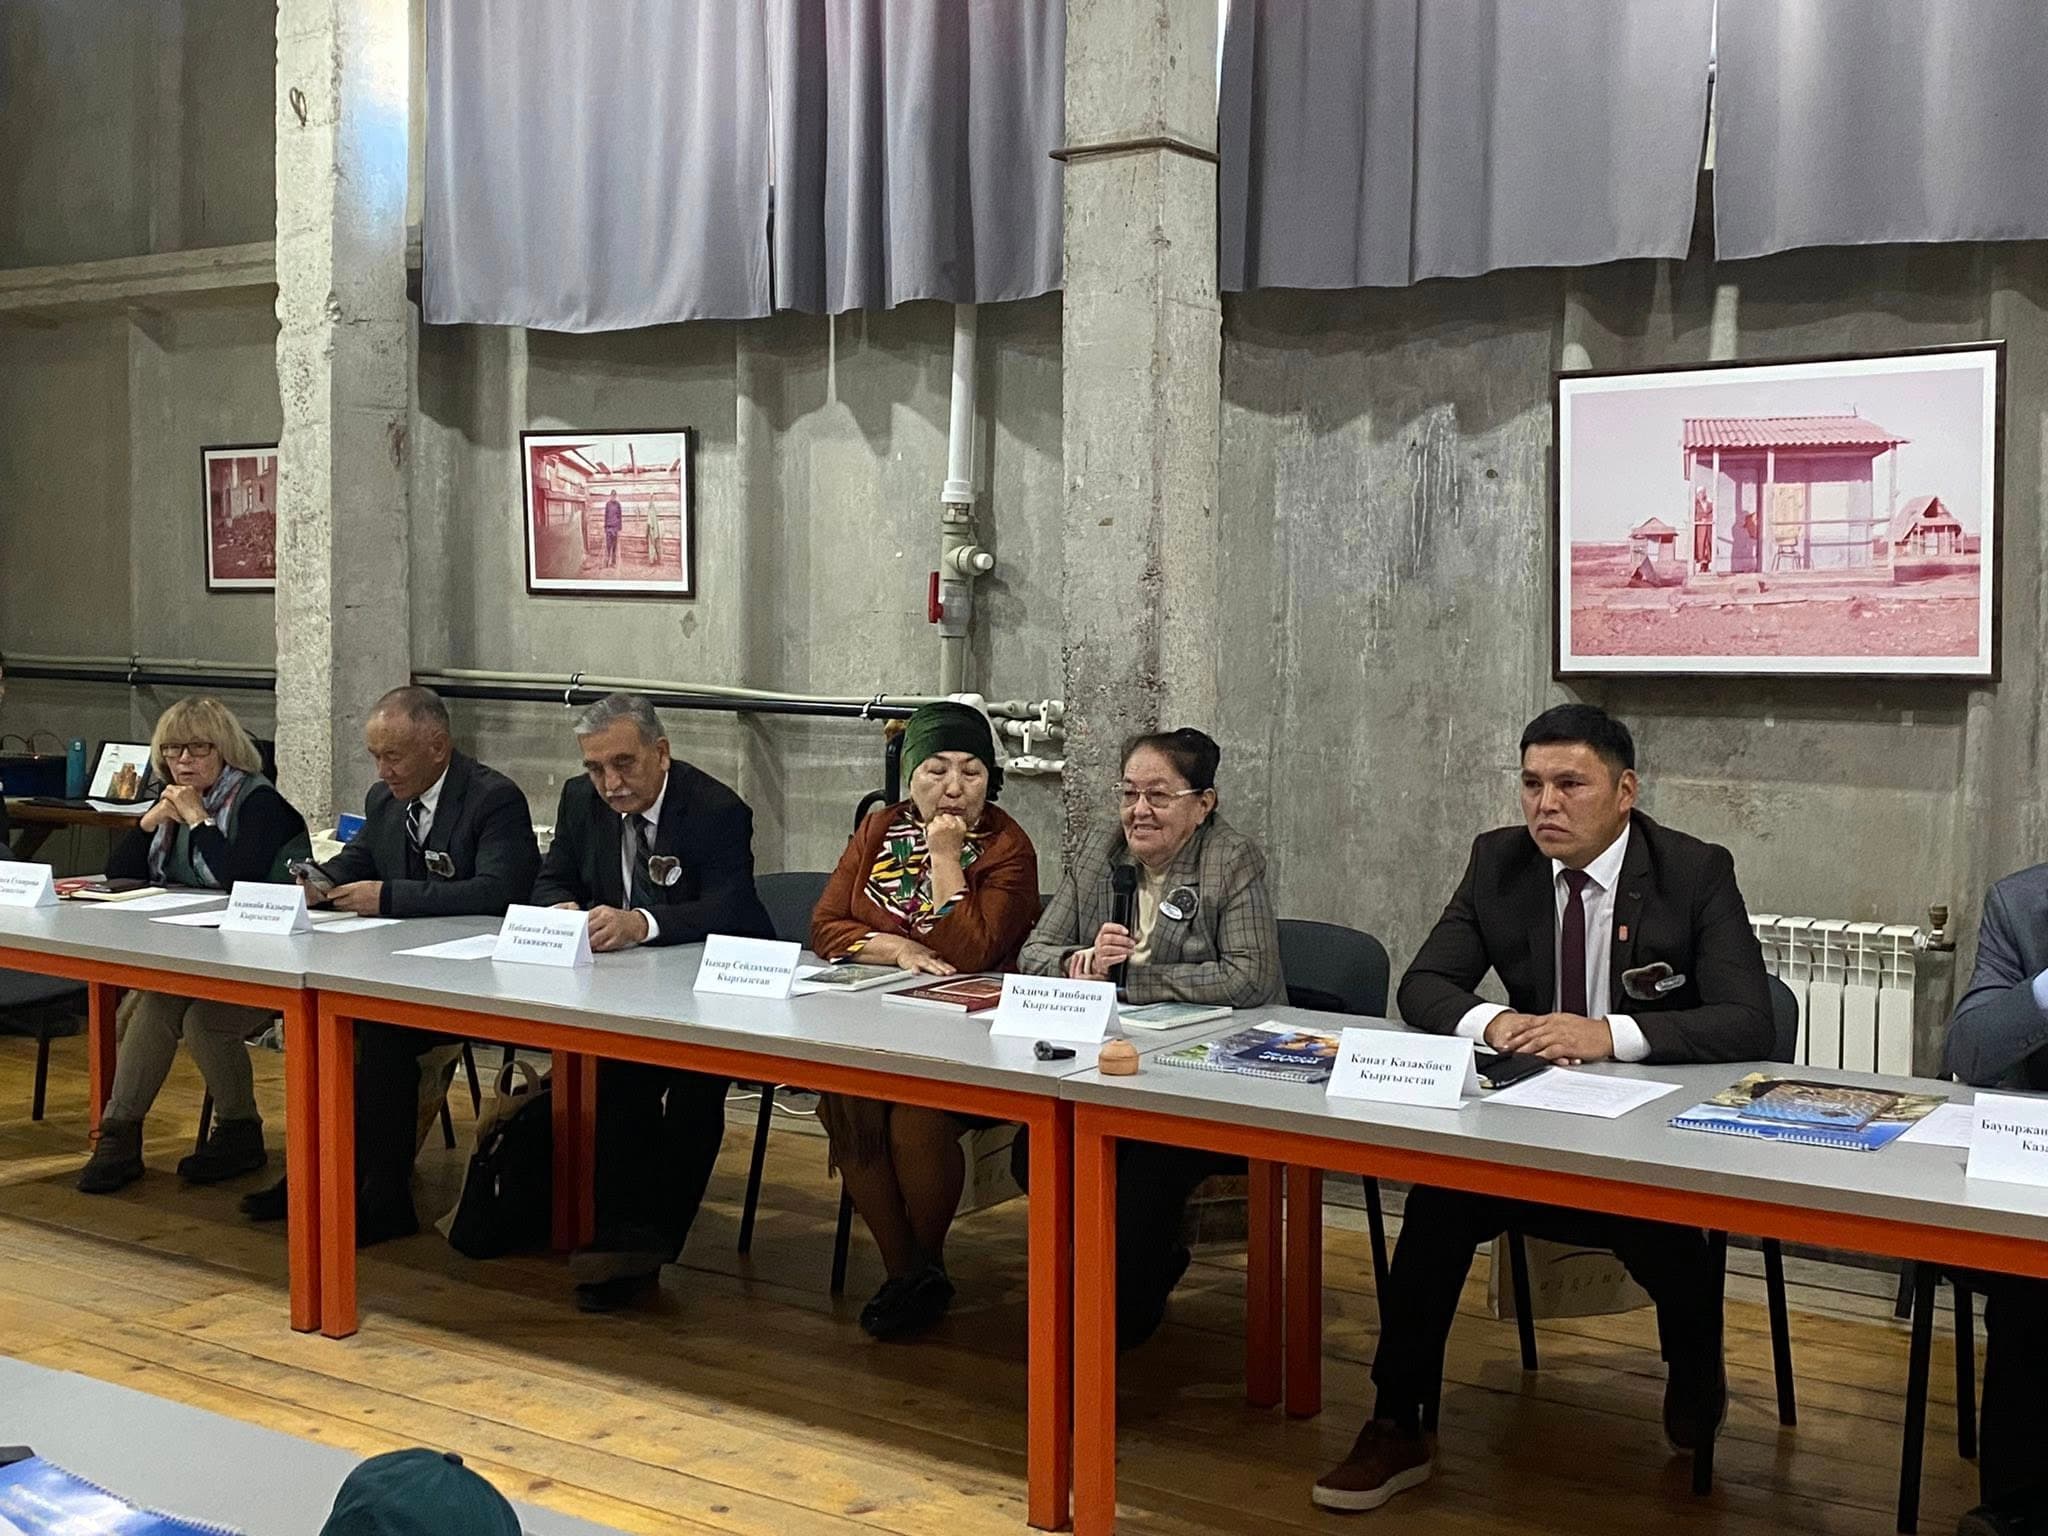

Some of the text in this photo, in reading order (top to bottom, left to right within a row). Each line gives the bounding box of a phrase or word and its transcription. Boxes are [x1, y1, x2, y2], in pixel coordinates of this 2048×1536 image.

[717, 972, 770, 985] Кыргызстан
[1012, 985, 1102, 1001] Кадича Ташбаева
[1022, 1000, 1086, 1013] Кыргызстан
[1351, 1053, 1452, 1072] Канат Казакбаев
[1360, 1070, 1435, 1086] Кыргызстан
